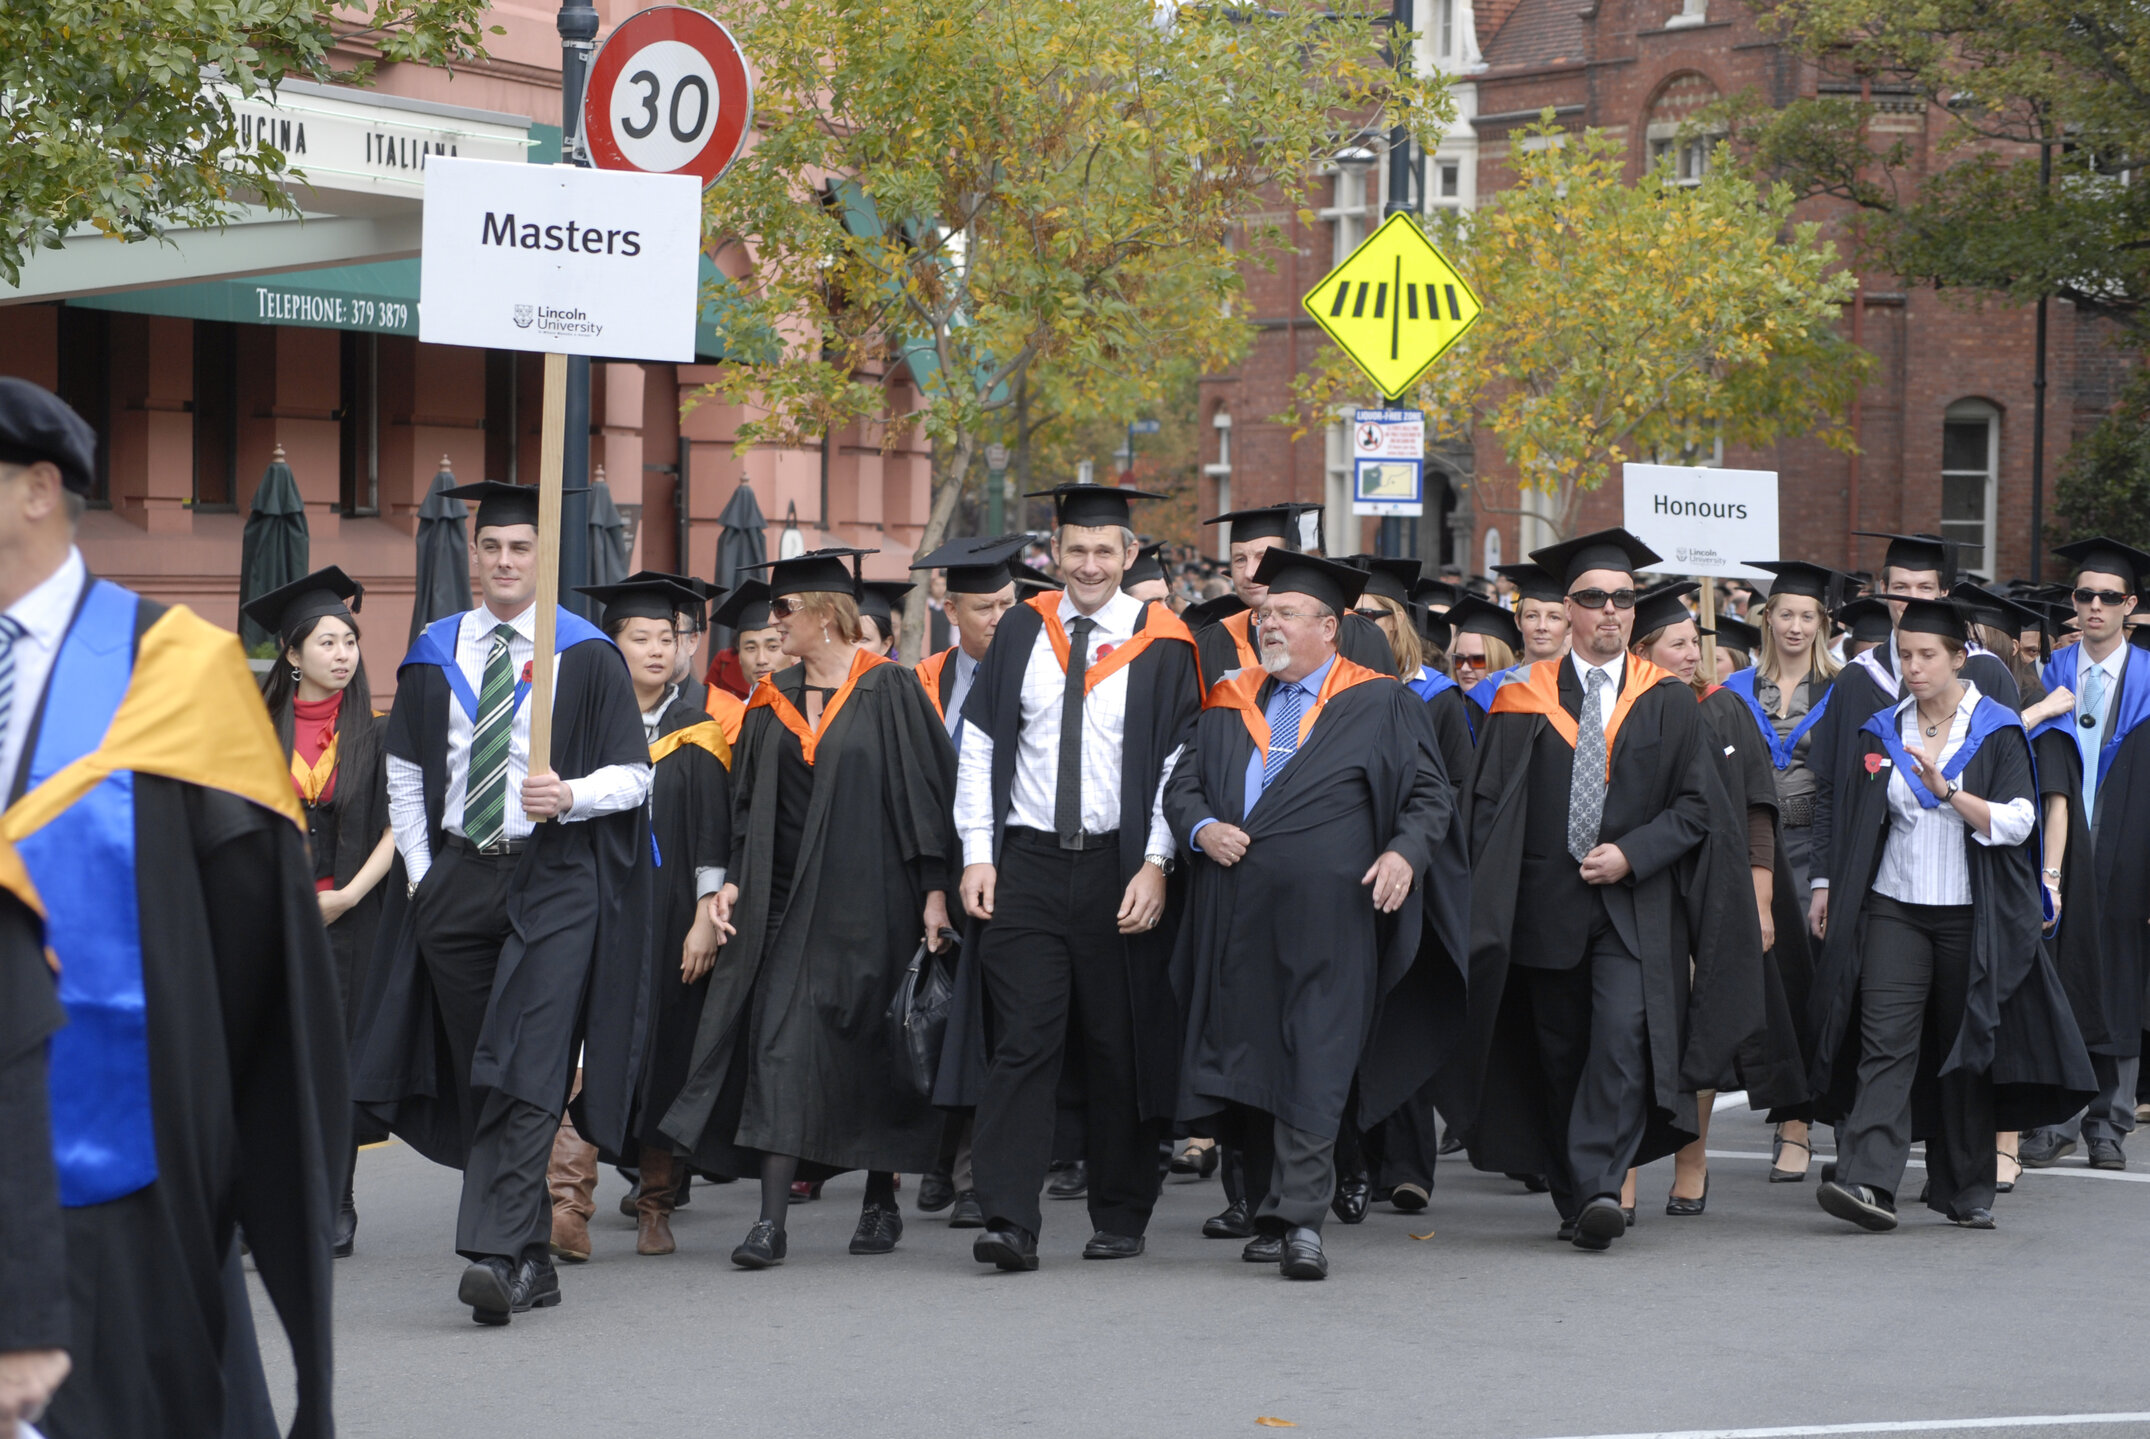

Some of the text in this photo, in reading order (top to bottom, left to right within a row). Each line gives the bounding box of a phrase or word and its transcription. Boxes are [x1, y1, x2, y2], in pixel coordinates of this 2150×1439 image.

[621, 70, 709, 143] 30
[482, 212, 641, 257] Masters
[256, 287, 347, 324] TELEPHONE:
[351, 299, 375, 326] 379
[378, 302, 408, 329] 3879
[538, 306, 586, 320] Lincoln
[538, 318, 603, 337] University
[1403, 411, 1422, 421] ZONE
[1654, 494, 1748, 519] Honours
[1689, 548, 1717, 556] Lincoln
[1689, 555, 1727, 567] University
